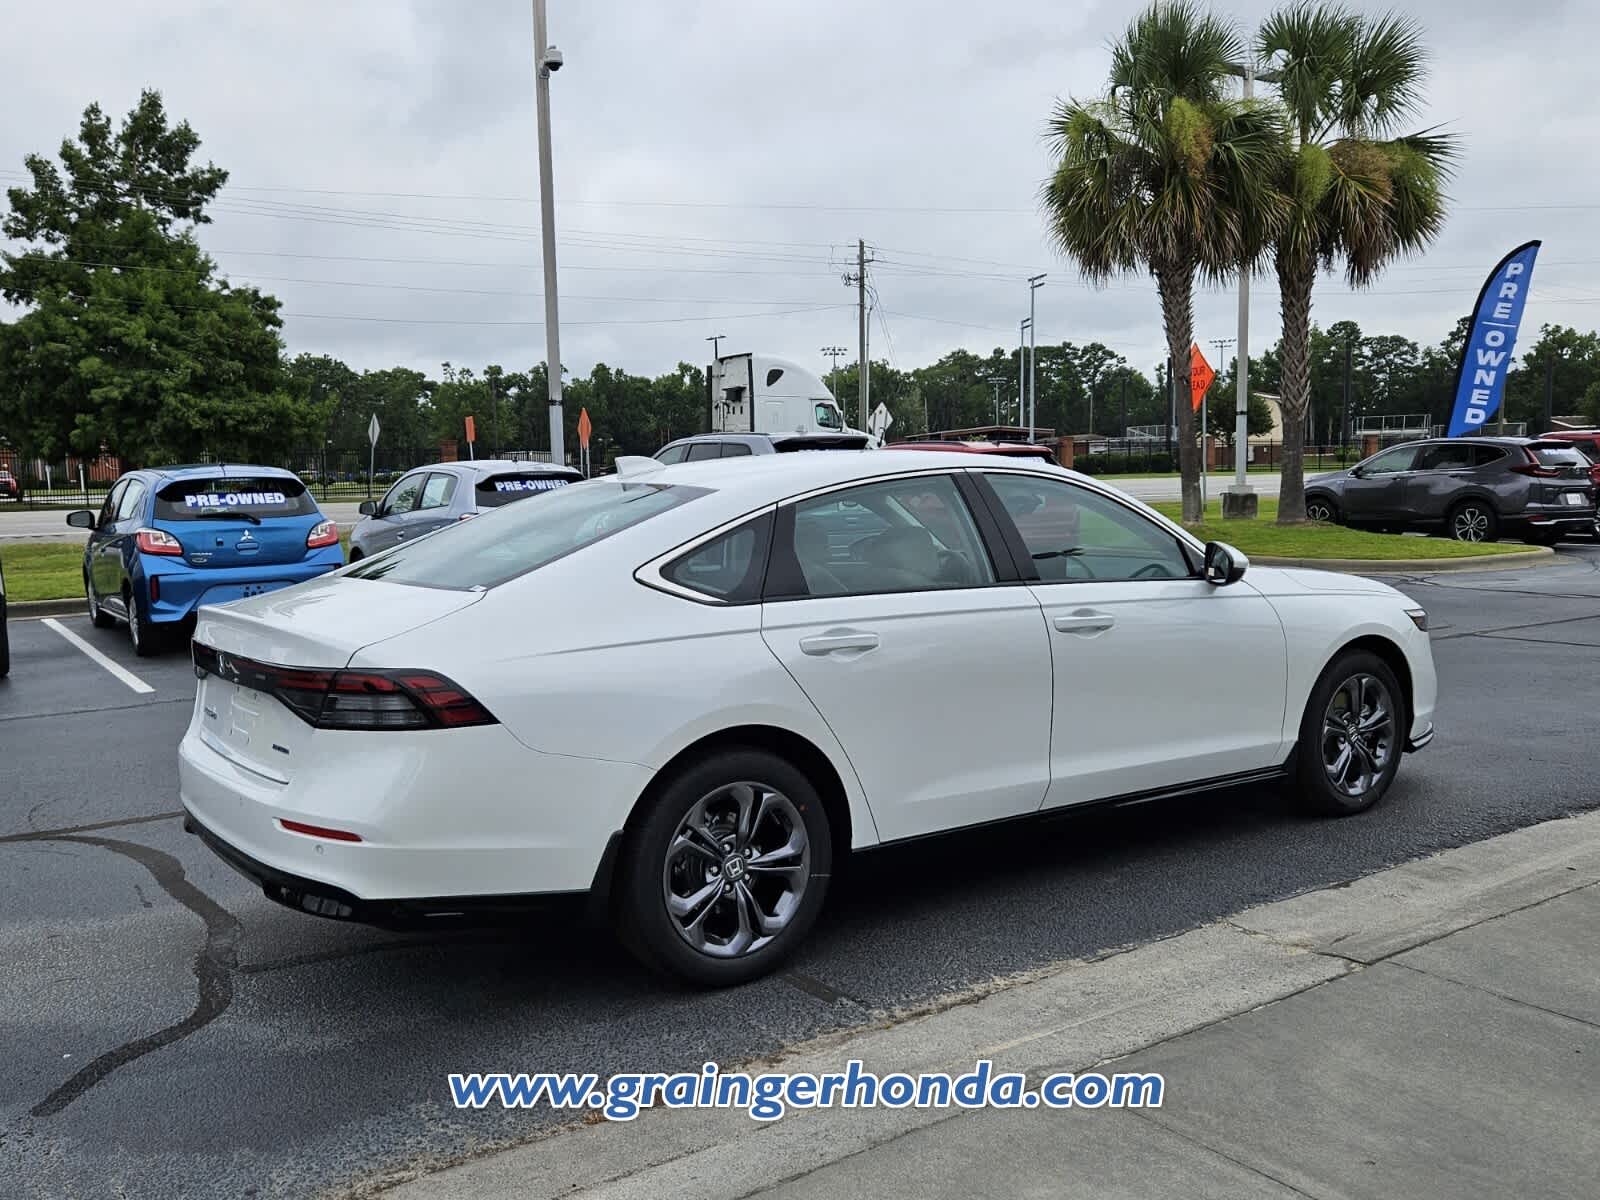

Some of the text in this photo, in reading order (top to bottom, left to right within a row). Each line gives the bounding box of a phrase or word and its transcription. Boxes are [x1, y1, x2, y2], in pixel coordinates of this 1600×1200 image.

[1464, 262, 1524, 425] PRE OWNED
[184, 492, 286, 507] PRE-OWNED
